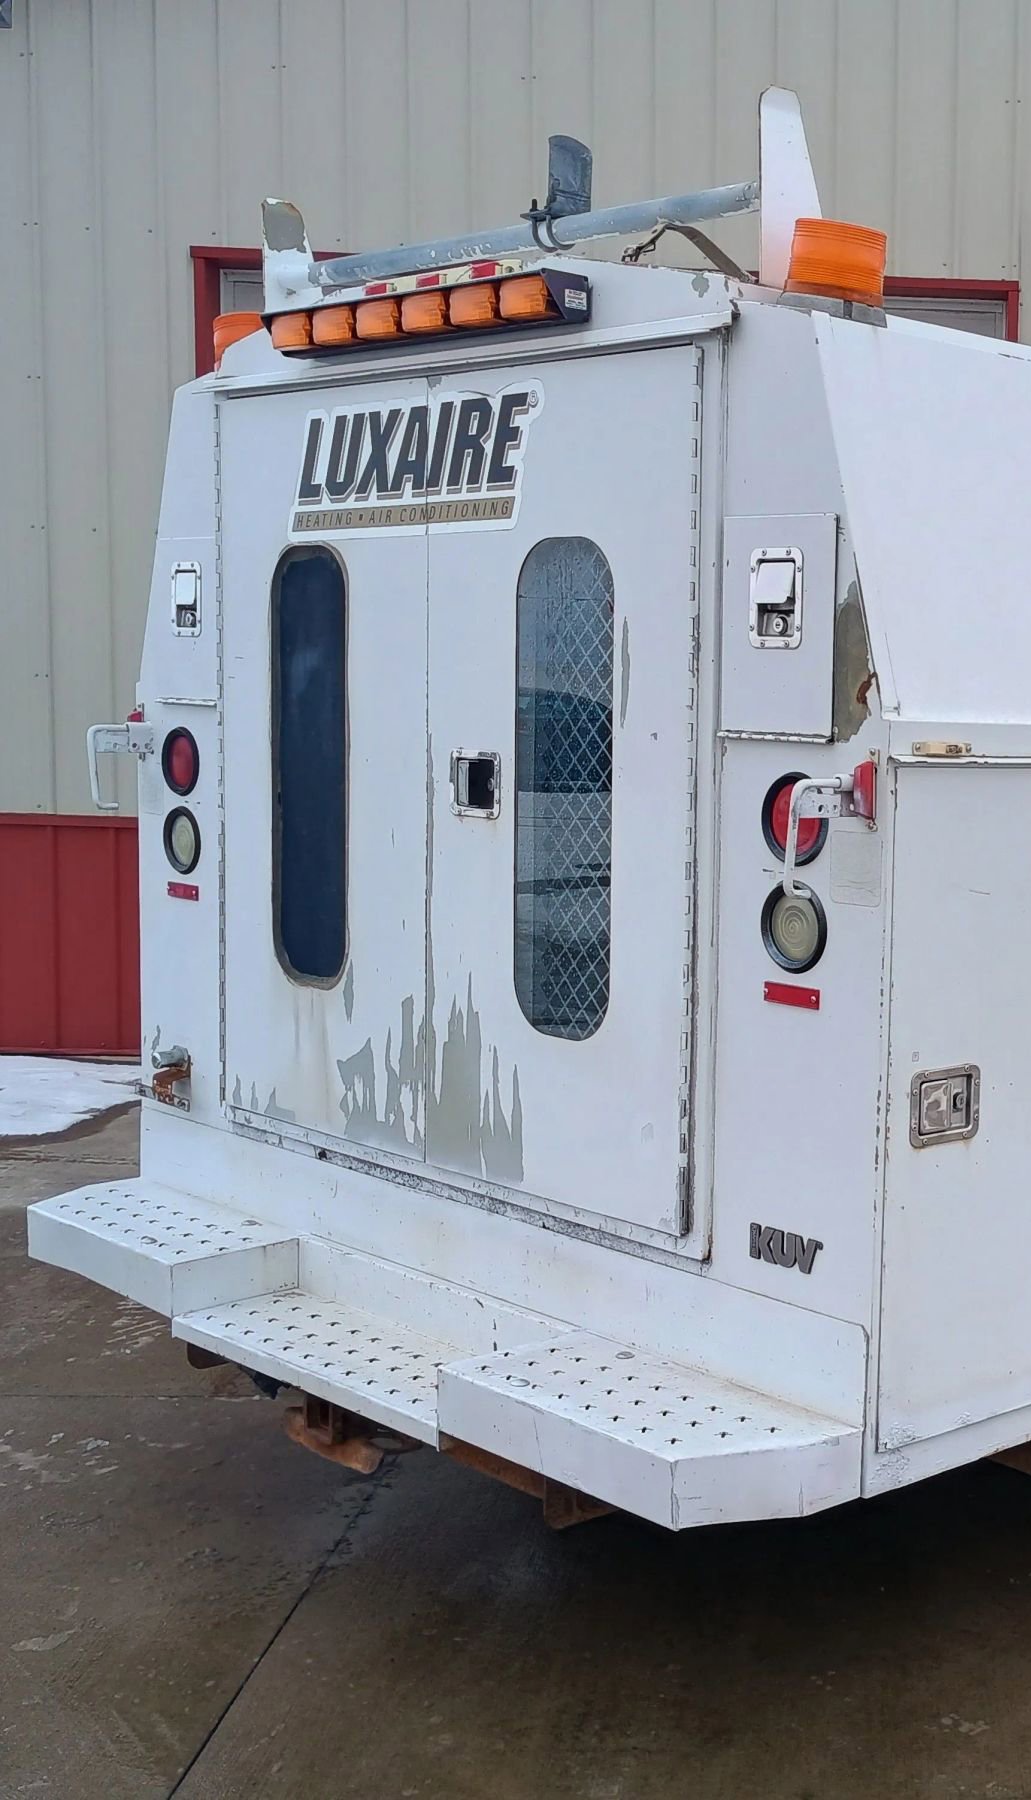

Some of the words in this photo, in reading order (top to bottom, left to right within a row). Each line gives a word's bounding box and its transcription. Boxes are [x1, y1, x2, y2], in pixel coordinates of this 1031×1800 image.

[296, 513, 353, 530] HEATING
[369, 509, 393, 523] AIR
[400, 500, 509, 521] CONDITIONING
[750, 1222, 821, 1274] KUV
